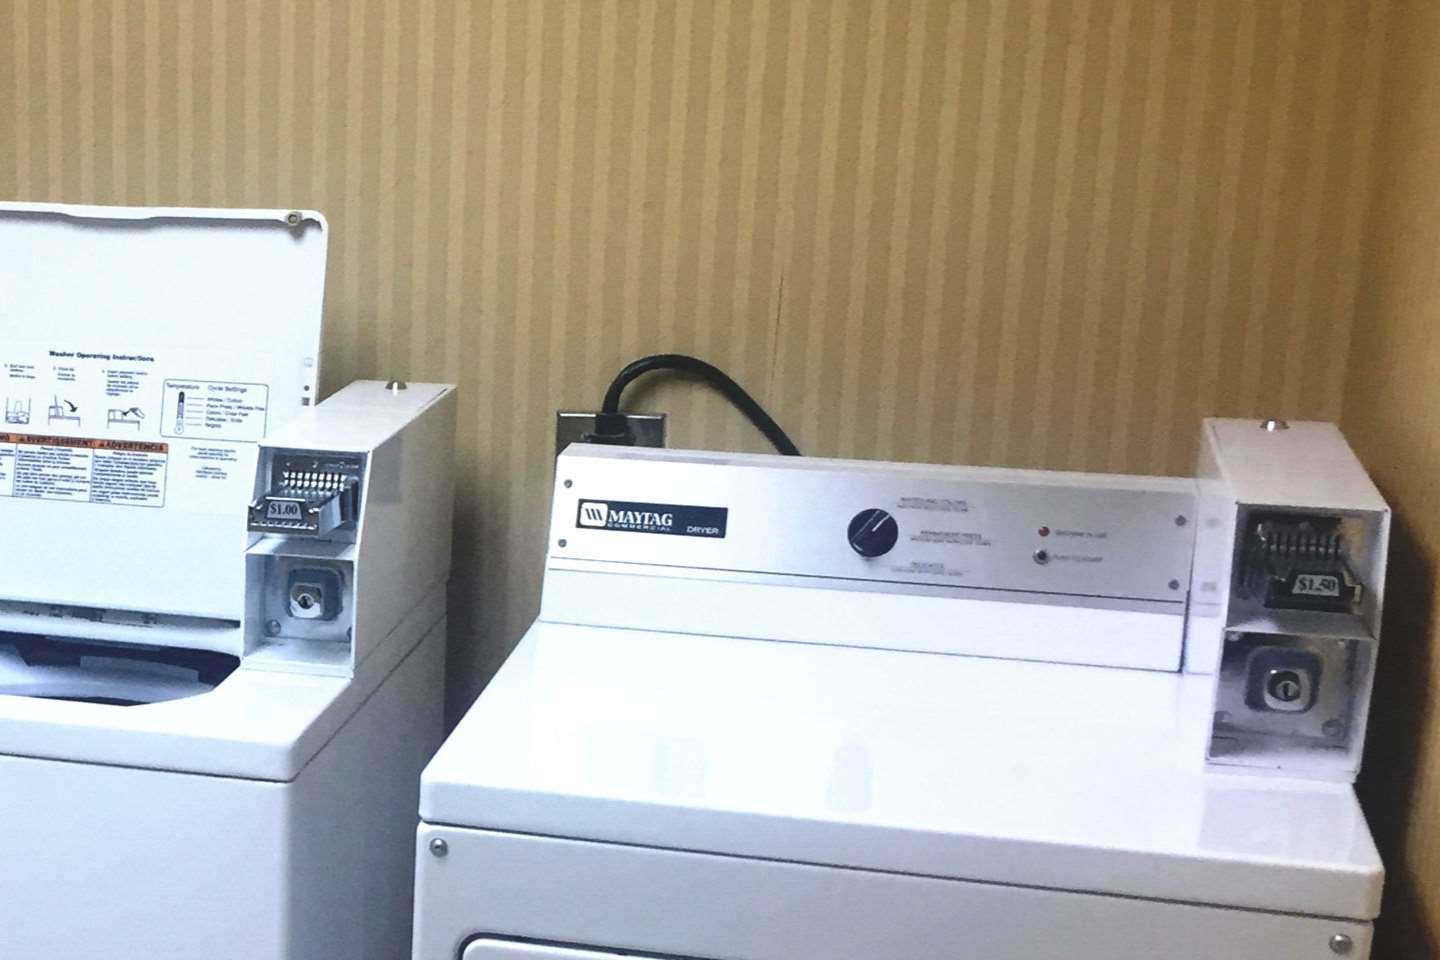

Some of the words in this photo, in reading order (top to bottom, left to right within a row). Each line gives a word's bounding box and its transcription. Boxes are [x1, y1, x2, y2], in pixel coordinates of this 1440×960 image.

[49, 350, 74, 358] Washer
[76, 351, 110, 361] Operating
[112, 353, 154, 362] Instructions
[166, 382, 200, 390] Temperature
[270, 502, 298, 516] $1.00
[609, 509, 673, 526] MAYTAG
[687, 525, 719, 535] DRYER
[1298, 575, 1336, 592] $1.50
